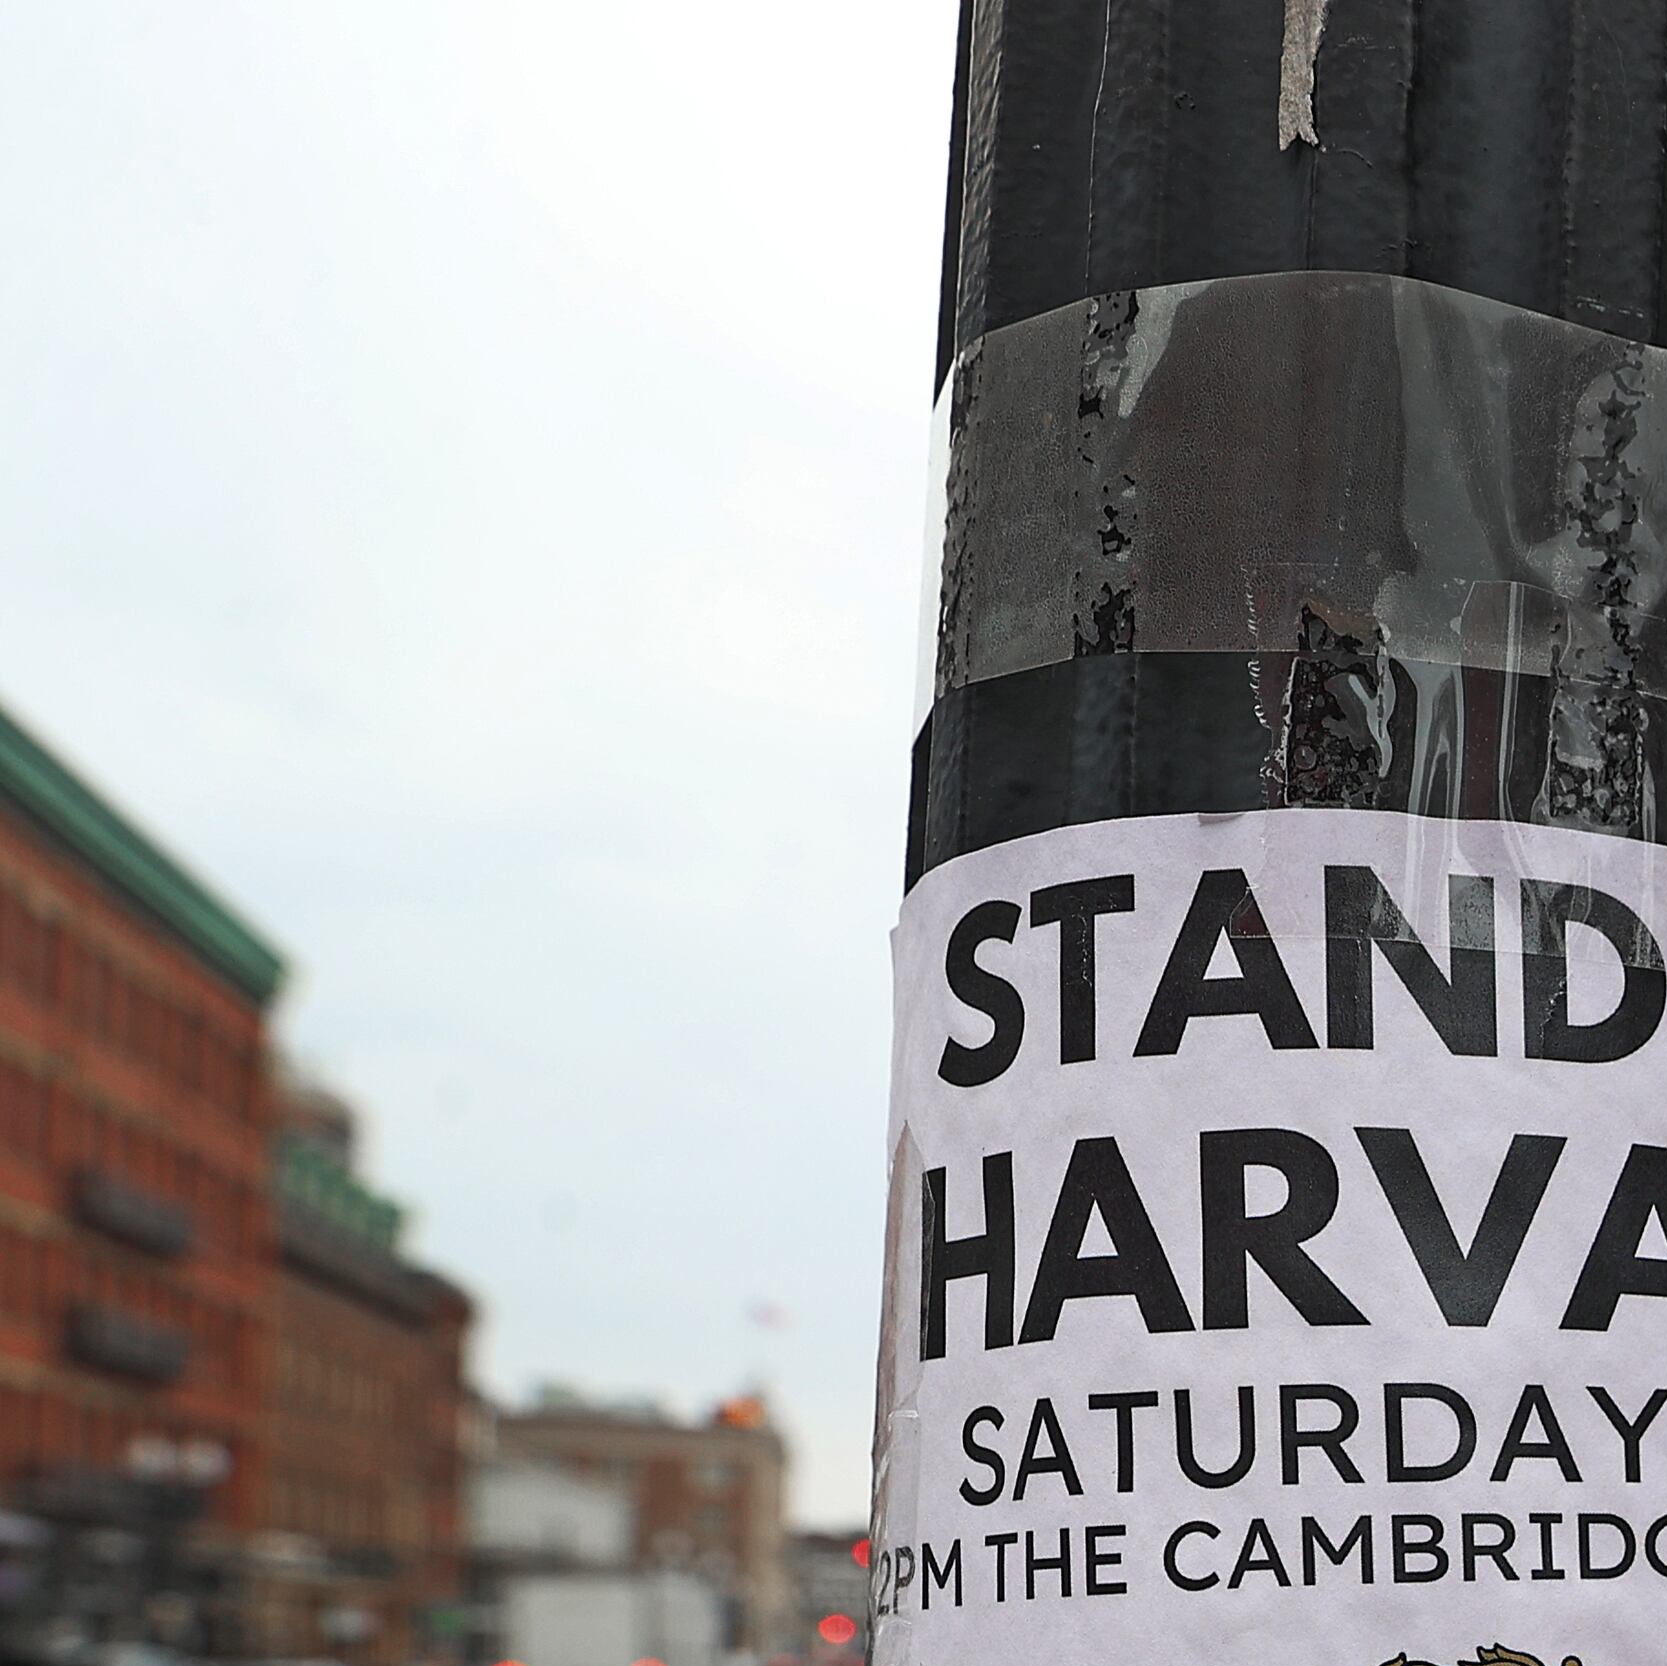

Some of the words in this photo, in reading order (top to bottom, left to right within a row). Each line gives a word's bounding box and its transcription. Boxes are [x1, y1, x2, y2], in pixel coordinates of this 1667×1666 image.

[938, 865, 1667, 1087] STAND
[876, 1539, 963, 1616] 2PM
[985, 1525, 1127, 1602] THE
